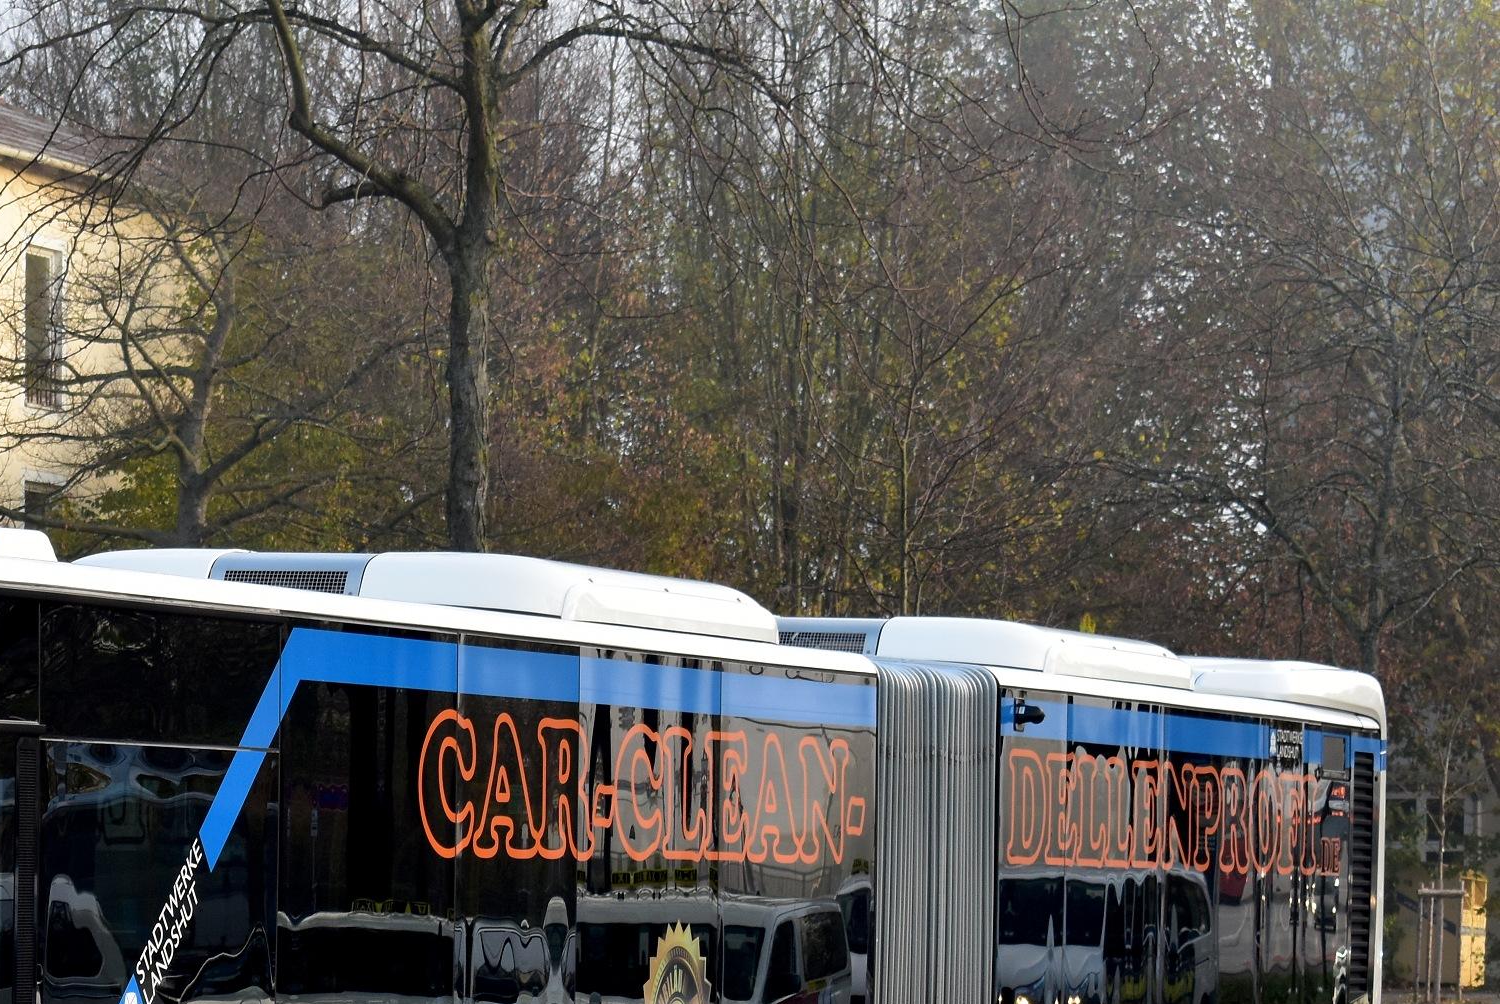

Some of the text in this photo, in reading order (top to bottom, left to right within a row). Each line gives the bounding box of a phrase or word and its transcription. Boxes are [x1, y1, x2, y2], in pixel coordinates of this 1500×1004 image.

[418, 709, 866, 865] CAR-CLEAN-
[1276, 745, 1299, 759] LANDSHUT
[136, 837, 203, 984] STADTWERKE
